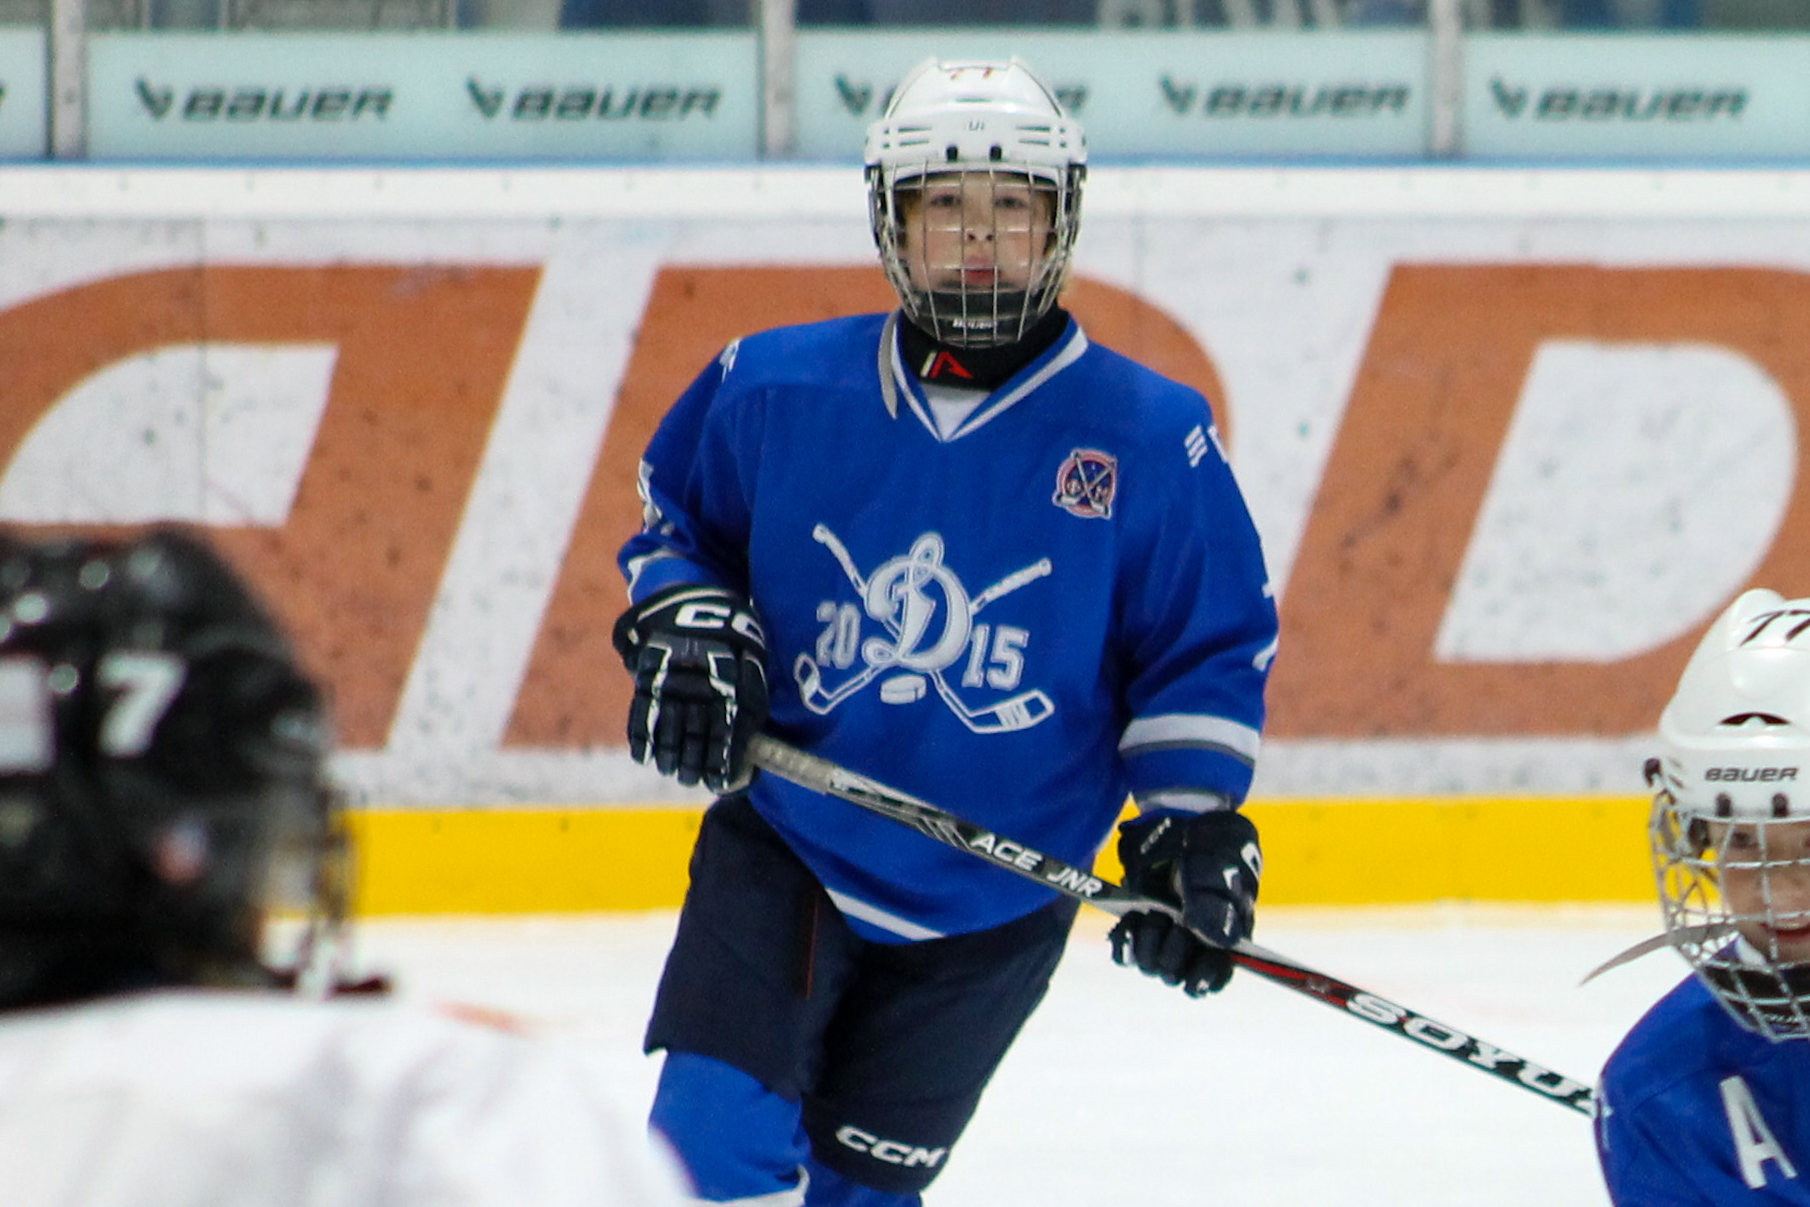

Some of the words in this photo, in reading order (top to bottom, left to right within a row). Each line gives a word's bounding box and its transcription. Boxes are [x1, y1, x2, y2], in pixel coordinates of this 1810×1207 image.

[962, 623, 1027, 690] 15
[100, 651, 187, 757] 7
[1704, 766, 1799, 783] BAUER
[969, 830, 1044, 873] ACE
[1045, 865, 1103, 898] JNR
[836, 1125, 946, 1168] CCM
[1720, 1074, 1798, 1189] A
